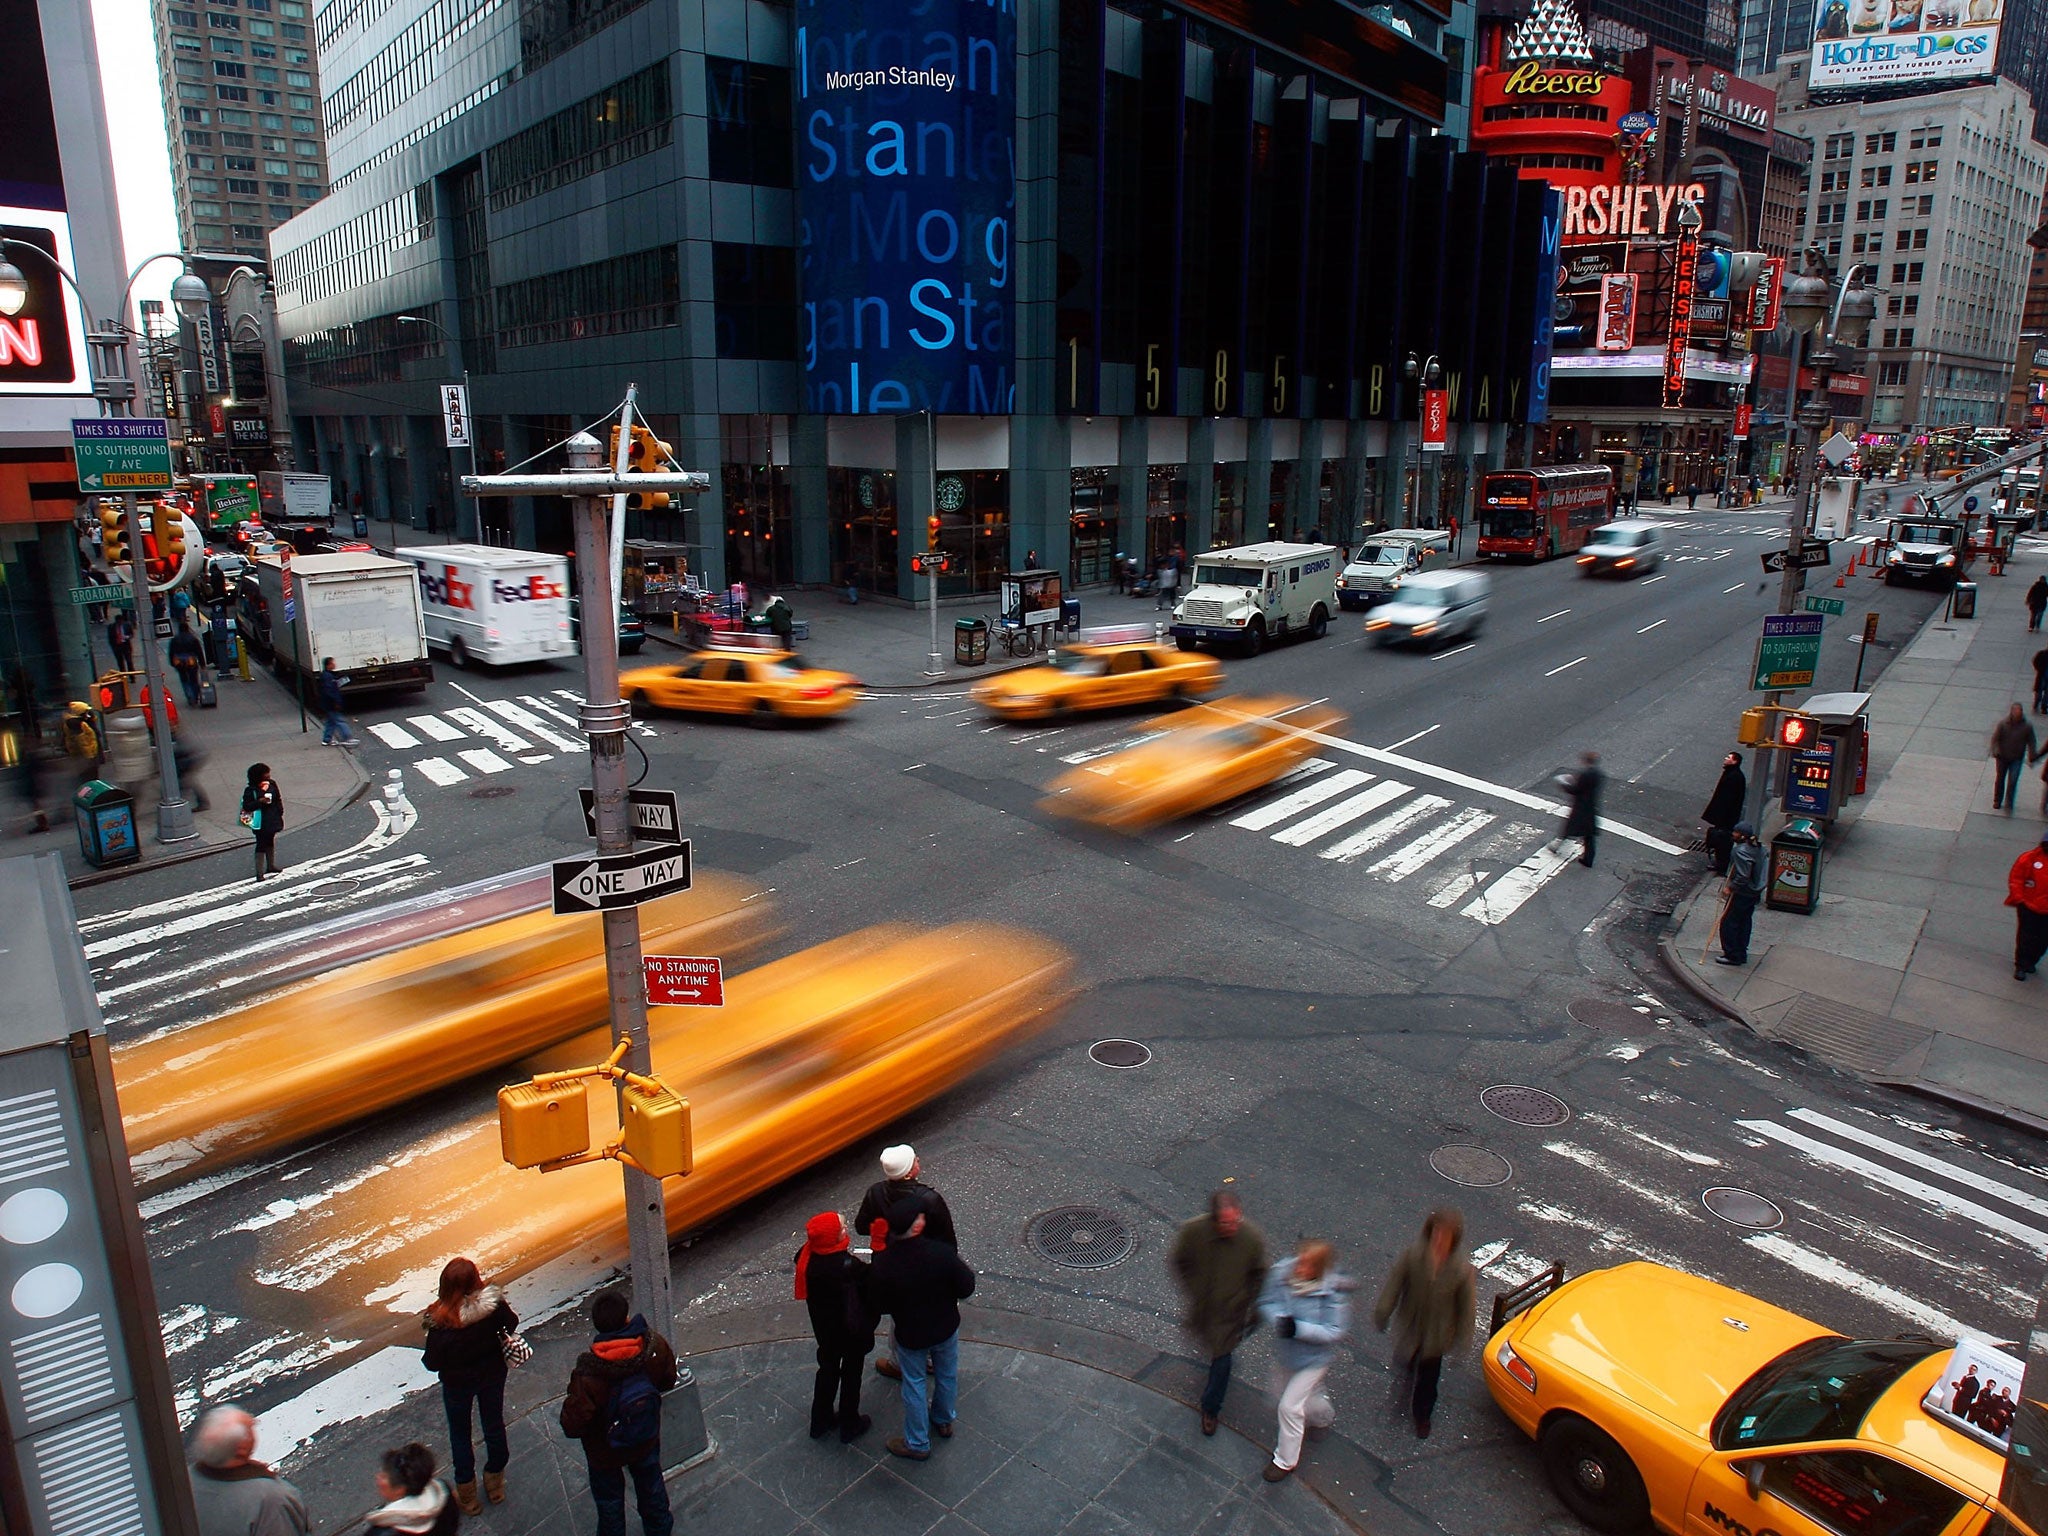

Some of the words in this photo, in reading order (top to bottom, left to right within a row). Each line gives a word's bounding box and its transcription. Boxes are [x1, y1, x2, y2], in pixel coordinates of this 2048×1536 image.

[1821, 36, 1898, 66] HOTEL
[1905, 60, 1942, 70] TURNED
[1947, 58, 1974, 66] AWAY
[826, 70, 885, 91] Morgan
[889, 66, 956, 92] Stanley
[1504, 61, 1606, 94] Reese's
[1628, 115, 1645, 123] JOLLY
[1680, 74, 1695, 158] HERSHEYS
[1622, 121, 1649, 129] RANCHER
[1569, 260, 1610, 275] Nuggets
[1669, 241, 1695, 391] HERSHEYS
[1692, 304, 1724, 320] ERSHEY'S
[164, 382, 174, 410] PARK
[76, 425, 103, 436] TIMES
[108, 425, 120, 436] SQ
[124, 425, 164, 436] SHUFFLE
[233, 420, 256, 432] EXIT
[234, 431, 248, 441] THE
[249, 431, 268, 441] KING
[78, 445, 92, 456] TO
[96, 445, 167, 456] SOUTHBOUND
[107, 459, 114, 470] 7
[121, 459, 142, 470] AVE
[105, 474, 135, 485] TURN
[139, 473, 168, 484] HERE
[1773, 555, 1786, 566] ON
[72, 586, 123, 603] BROADWAY
[491, 575, 566, 604] FedEx
[1808, 597, 1815, 610] W
[1819, 599, 1829, 612] 47
[1766, 623, 1782, 633] TIMES
[1786, 622, 1793, 632] SQ
[1796, 621, 1821, 633] SHUFFLE
[1763, 644, 1771, 654] TO
[1774, 642, 1818, 654] SOUTHBOUND
[1777, 658, 1782, 668] 7
[1786, 657, 1800, 668] AVE
[1771, 672, 1790, 684] TURN
[1793, 671, 1812, 683] HERE
[1805, 766, 1830, 780] 171
[1797, 779, 1828, 789] MILLION
[637, 805, 665, 827] WAY
[579, 872, 625, 896] ONE
[642, 859, 676, 887] WAY
[648, 961, 662, 972] NO
[667, 962, 716, 974] STANDING
[658, 975, 709, 986] ANYTIME
